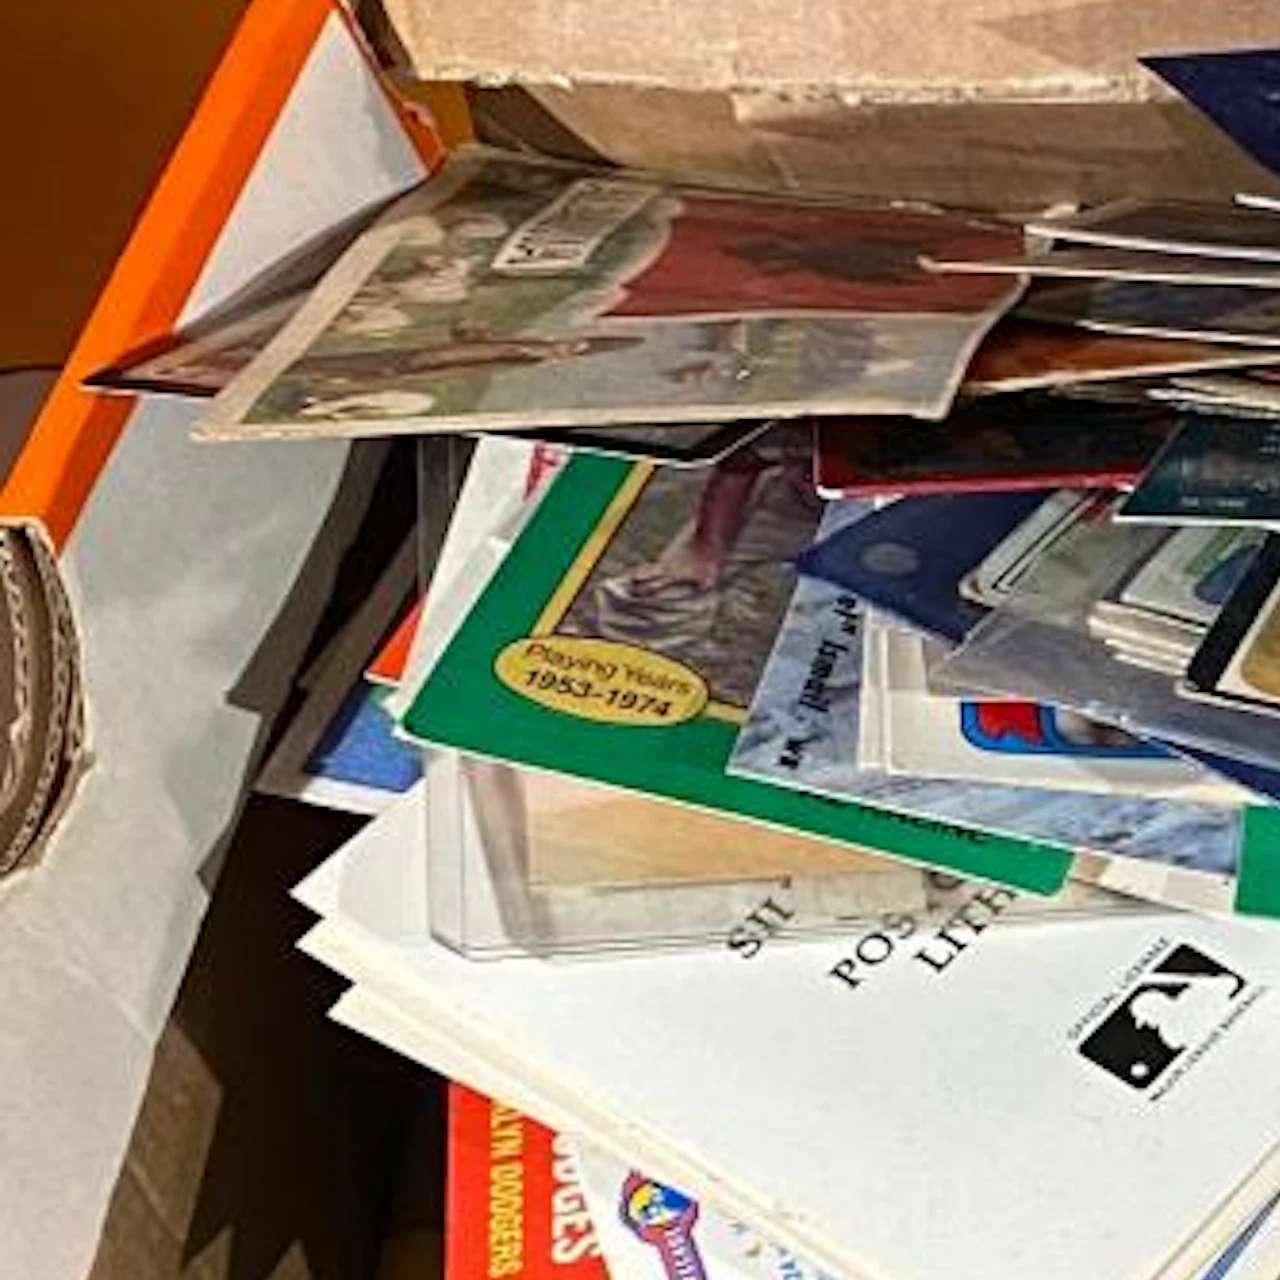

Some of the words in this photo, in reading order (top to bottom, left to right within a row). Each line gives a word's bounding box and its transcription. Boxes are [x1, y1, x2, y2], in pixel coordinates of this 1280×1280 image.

[524, 669, 675, 718] 1953-1974
[526, 642, 616, 680] Playing
[622, 664, 696, 697] Years
